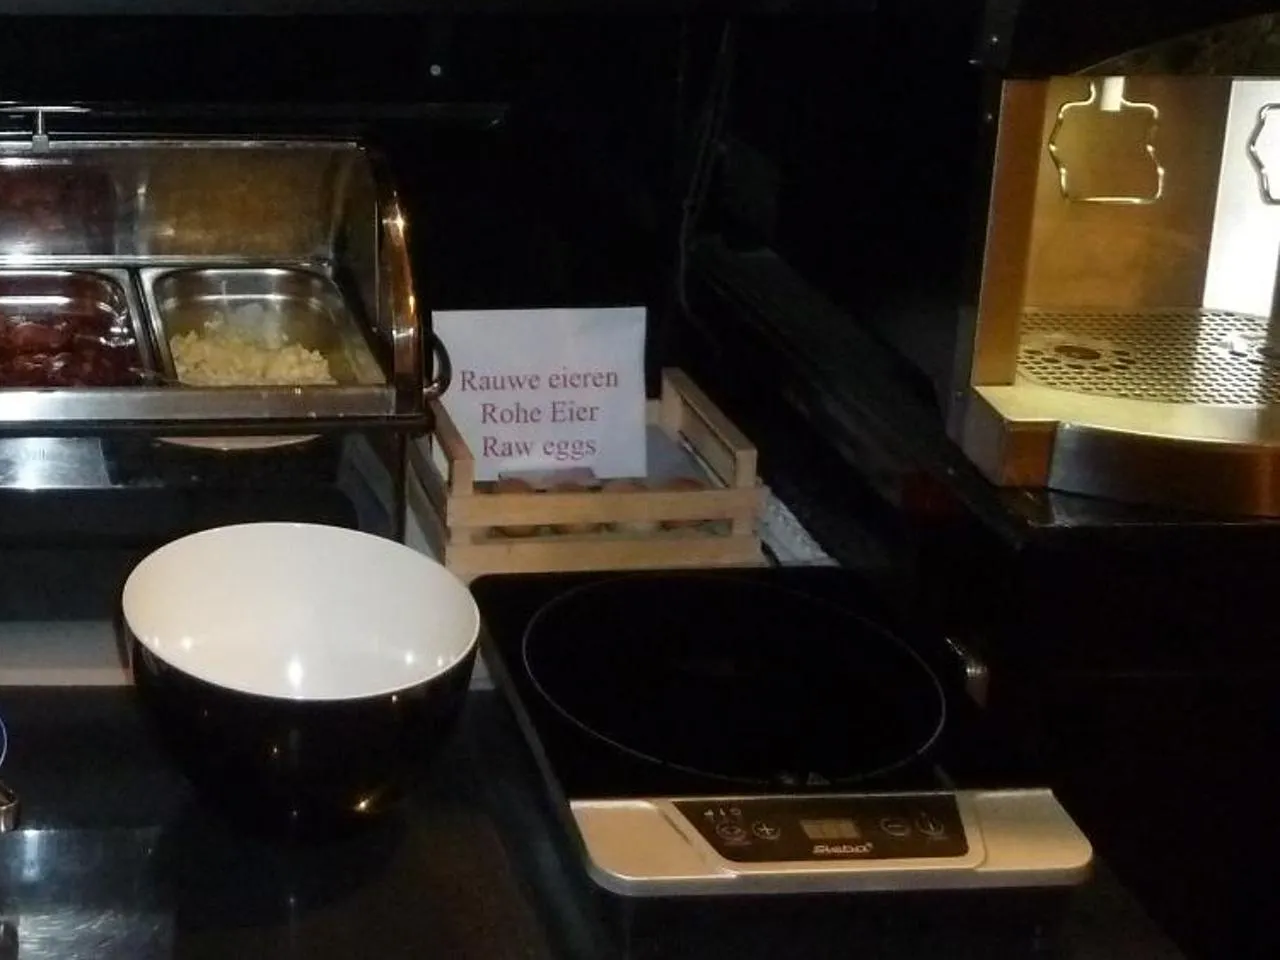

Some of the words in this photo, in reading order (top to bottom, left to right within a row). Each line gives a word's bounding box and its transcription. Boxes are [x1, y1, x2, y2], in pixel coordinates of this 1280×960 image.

[460, 369, 541, 392] Rauwe
[548, 367, 619, 389] eieren
[481, 402, 542, 424] Rohe
[551, 400, 600, 423] Eier
[482, 436, 533, 458] Raw
[542, 440, 597, 461] eggs
